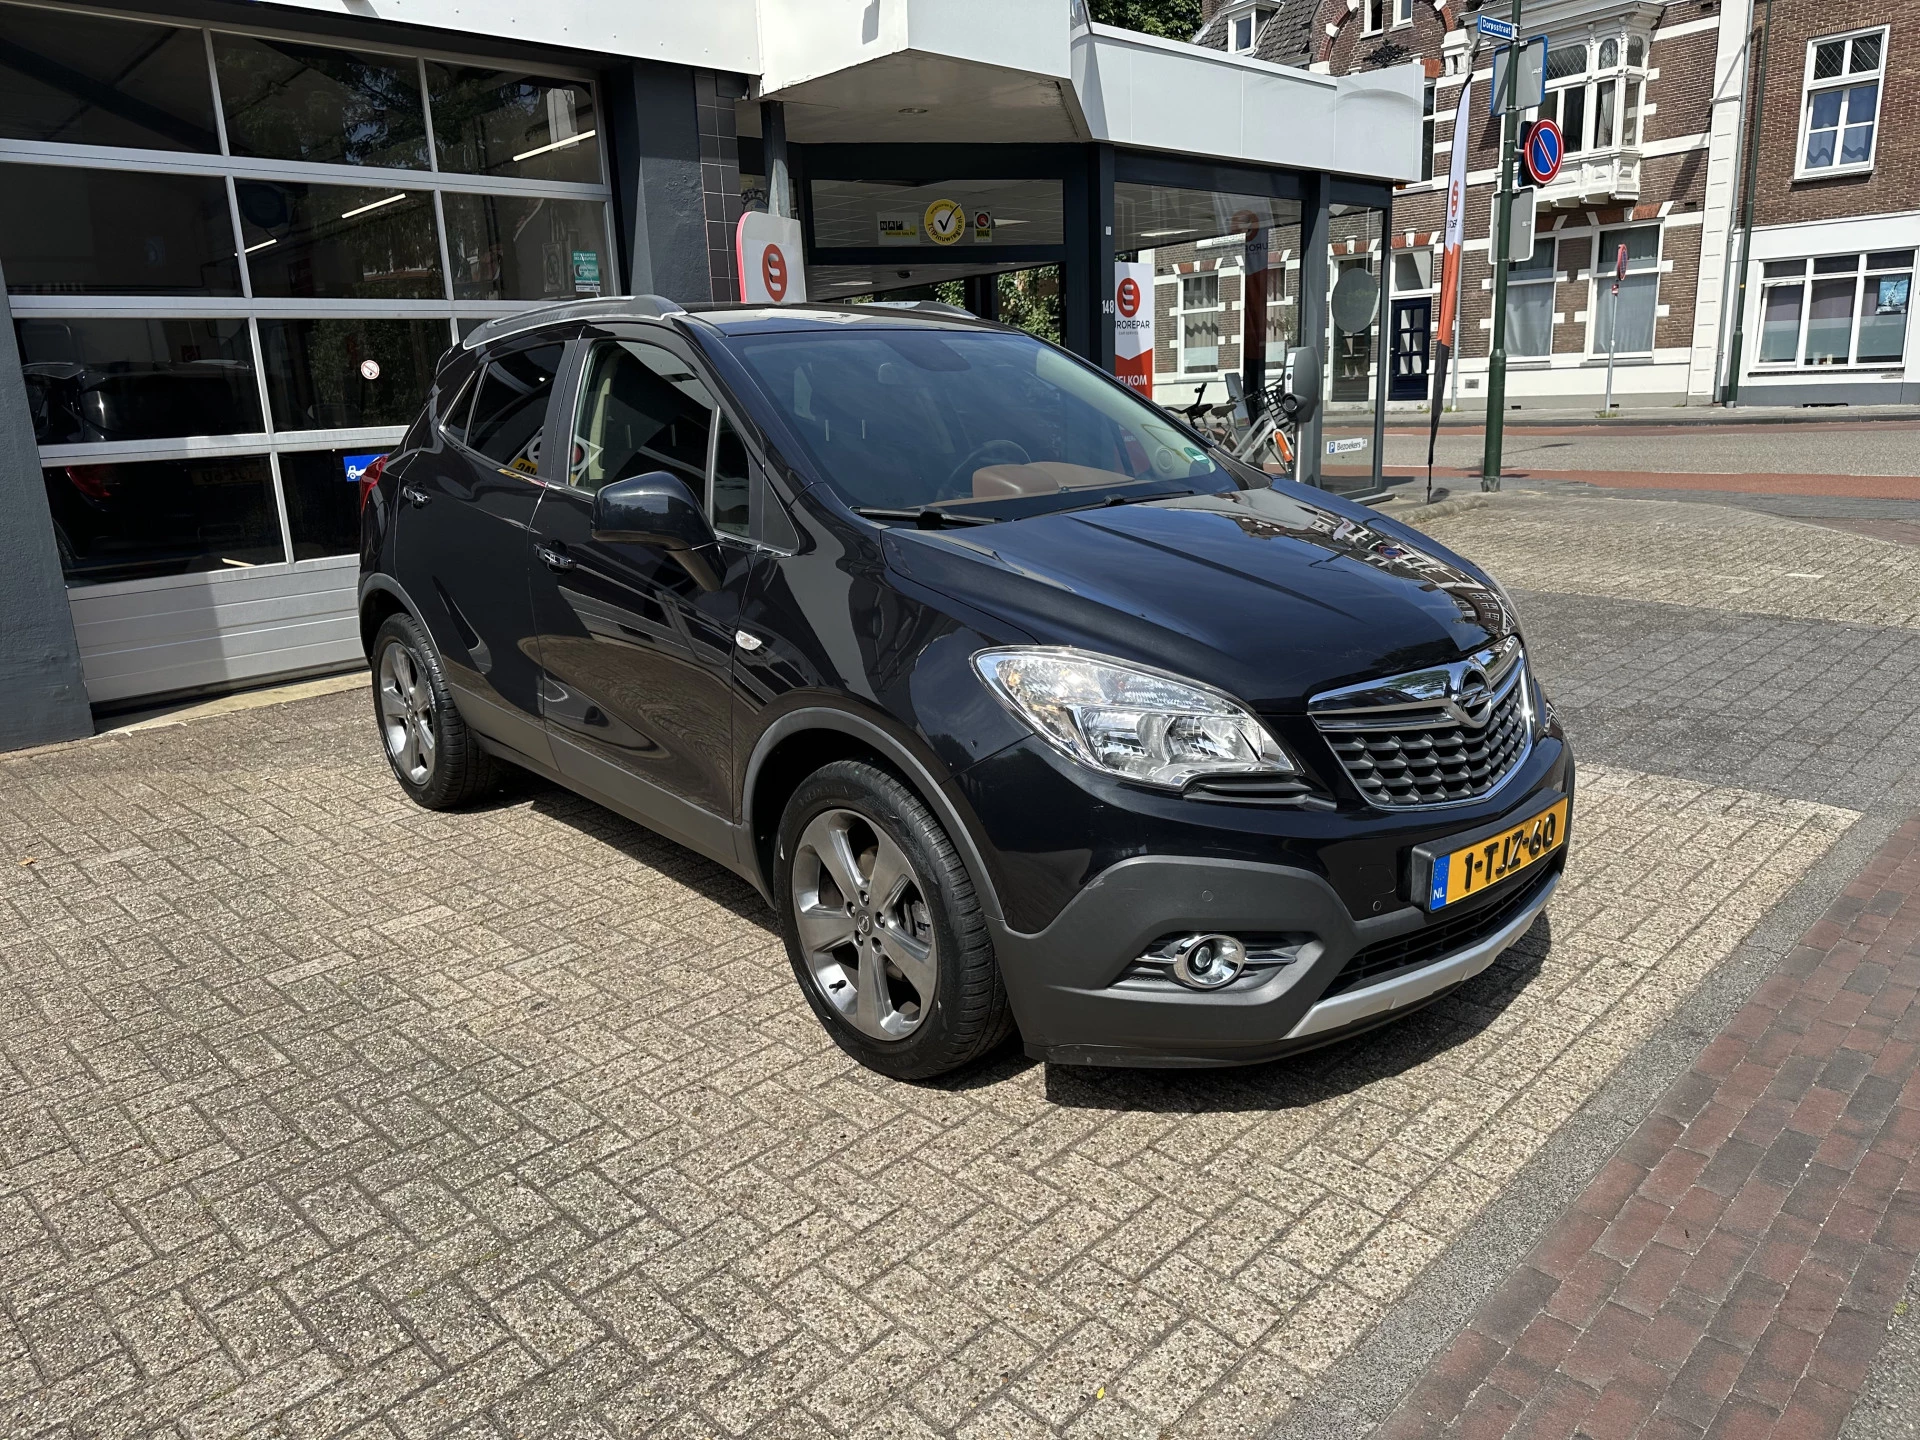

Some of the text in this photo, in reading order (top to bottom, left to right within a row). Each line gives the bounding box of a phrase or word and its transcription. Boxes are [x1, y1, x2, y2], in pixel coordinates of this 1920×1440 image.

[1482, 19, 1512, 34] Dorpsstraat
[741, 189, 768, 204] CHA
[880, 221, 903, 230] NAP
[1102, 300, 1115, 314] 148
[1337, 441, 1361, 450] Bezoekers
[1465, 813, 1556, 890] 1-TJZ-60
[1433, 887, 1445, 901] NL
